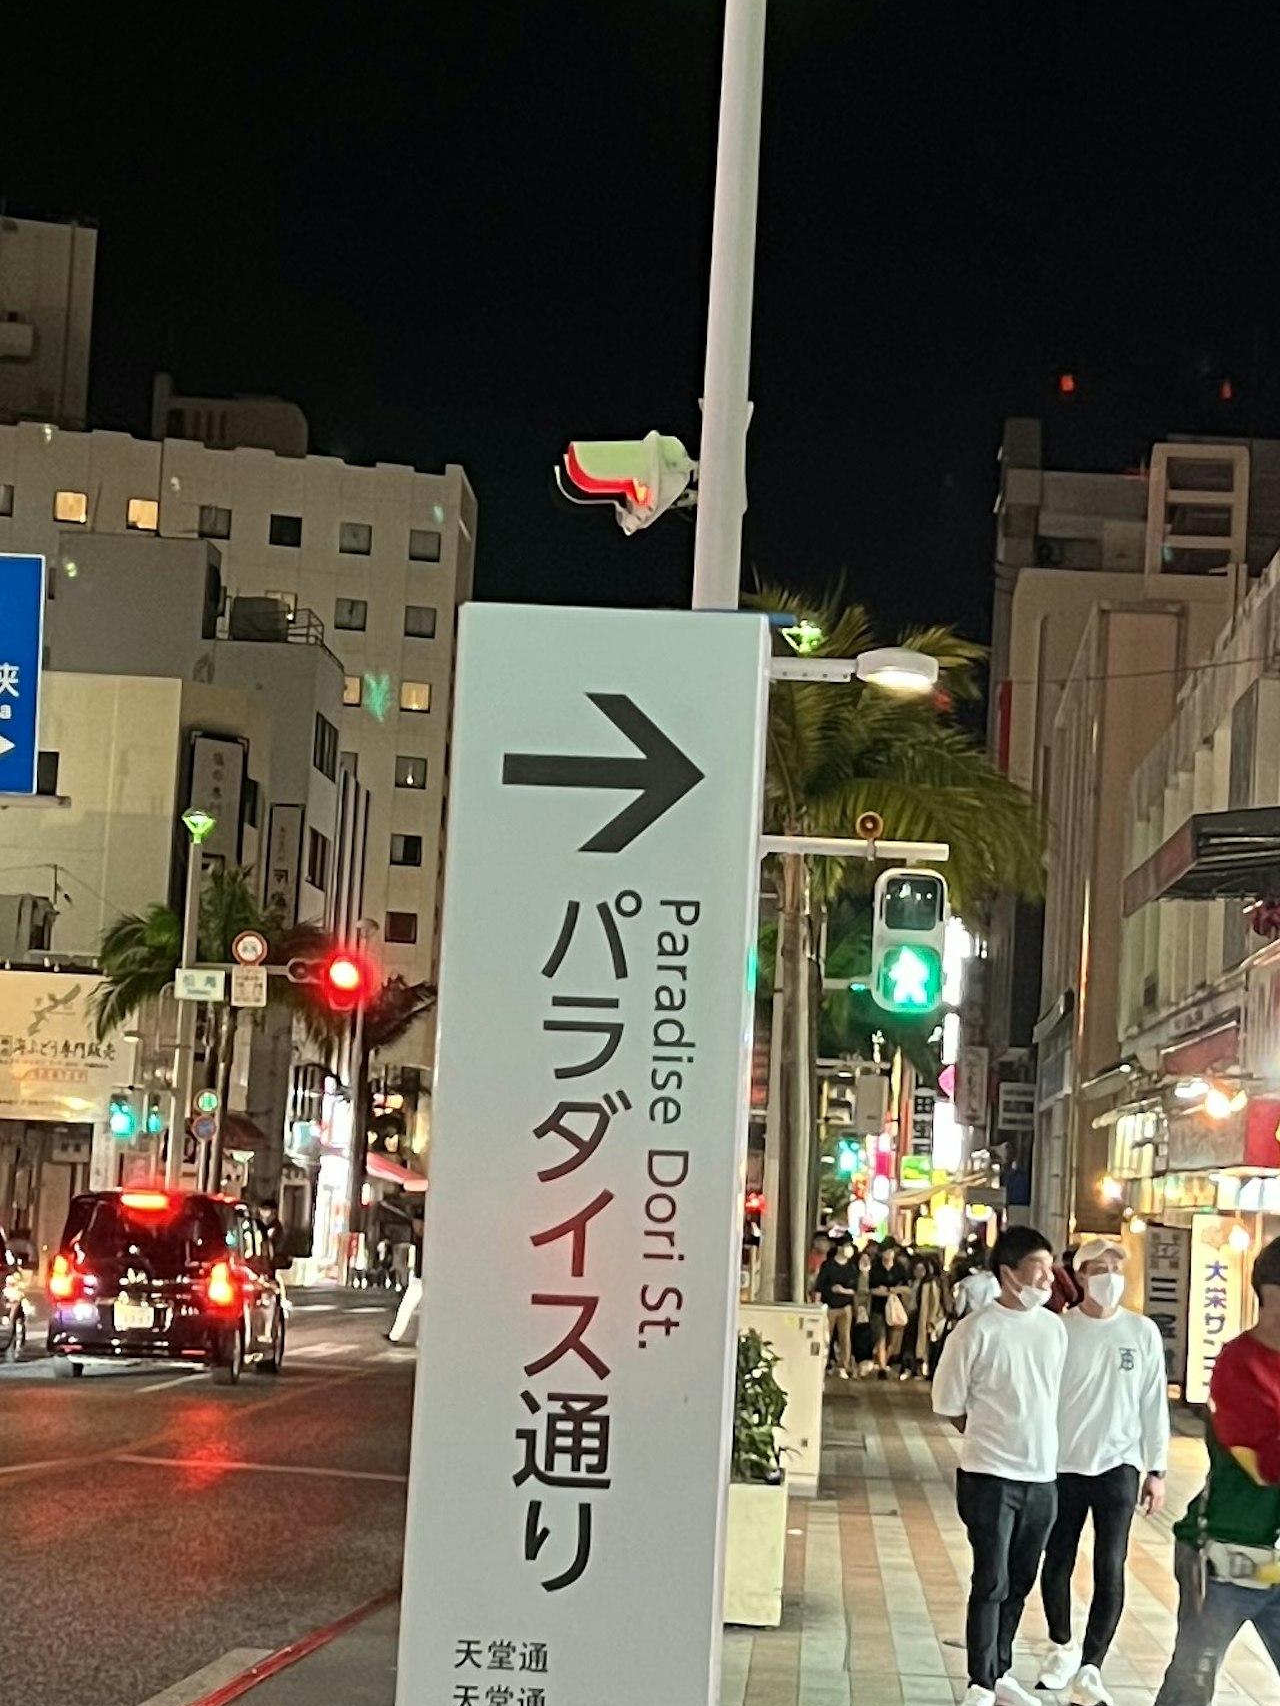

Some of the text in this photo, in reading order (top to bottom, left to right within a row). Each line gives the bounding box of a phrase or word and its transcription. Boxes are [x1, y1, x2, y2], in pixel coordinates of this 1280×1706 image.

[512, 890, 645, 1593] パラダイス通り
[638, 900, 701, 1349] Paradise Dori St.
[454, 1639, 548, 1673] 天堂通
